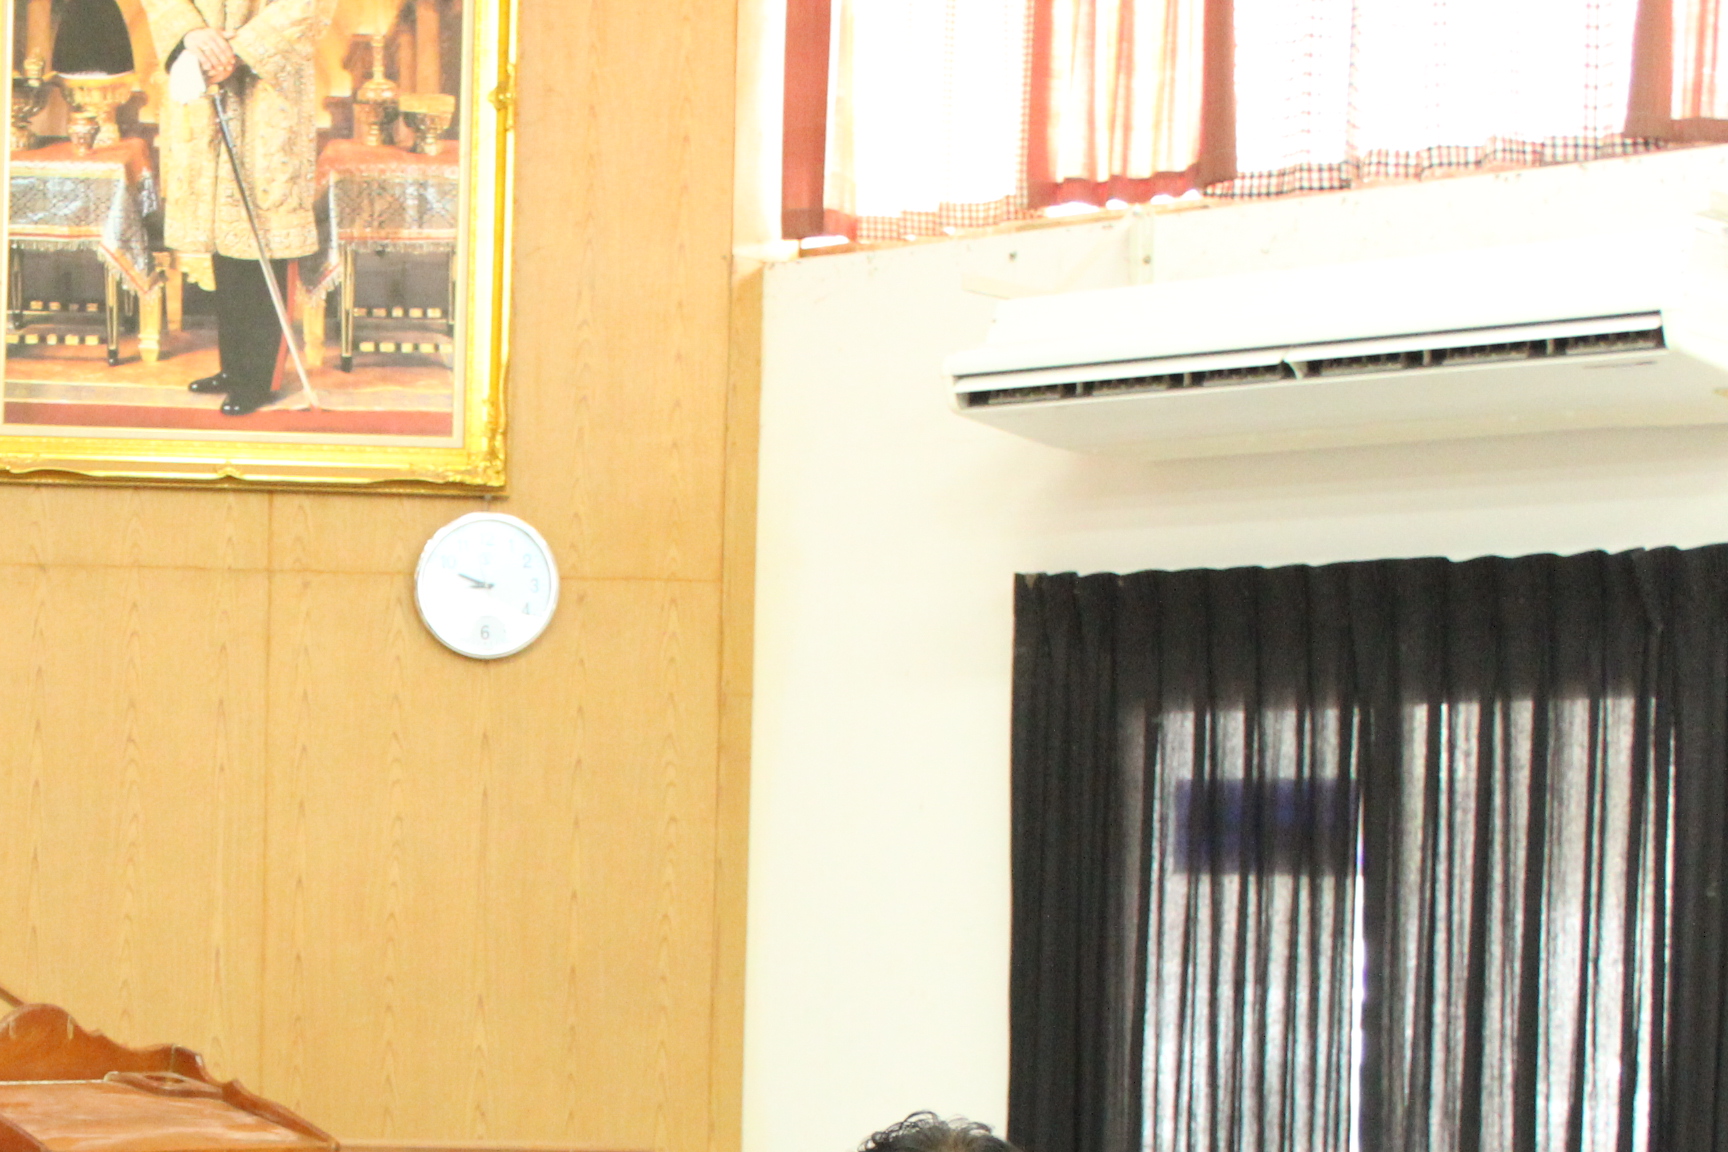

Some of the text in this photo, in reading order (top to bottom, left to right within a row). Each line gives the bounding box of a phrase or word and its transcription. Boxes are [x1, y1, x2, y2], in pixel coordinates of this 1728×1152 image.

[522, 553, 532, 569] 2
[530, 577, 540, 593] 3
[480, 625, 490, 640] 6
